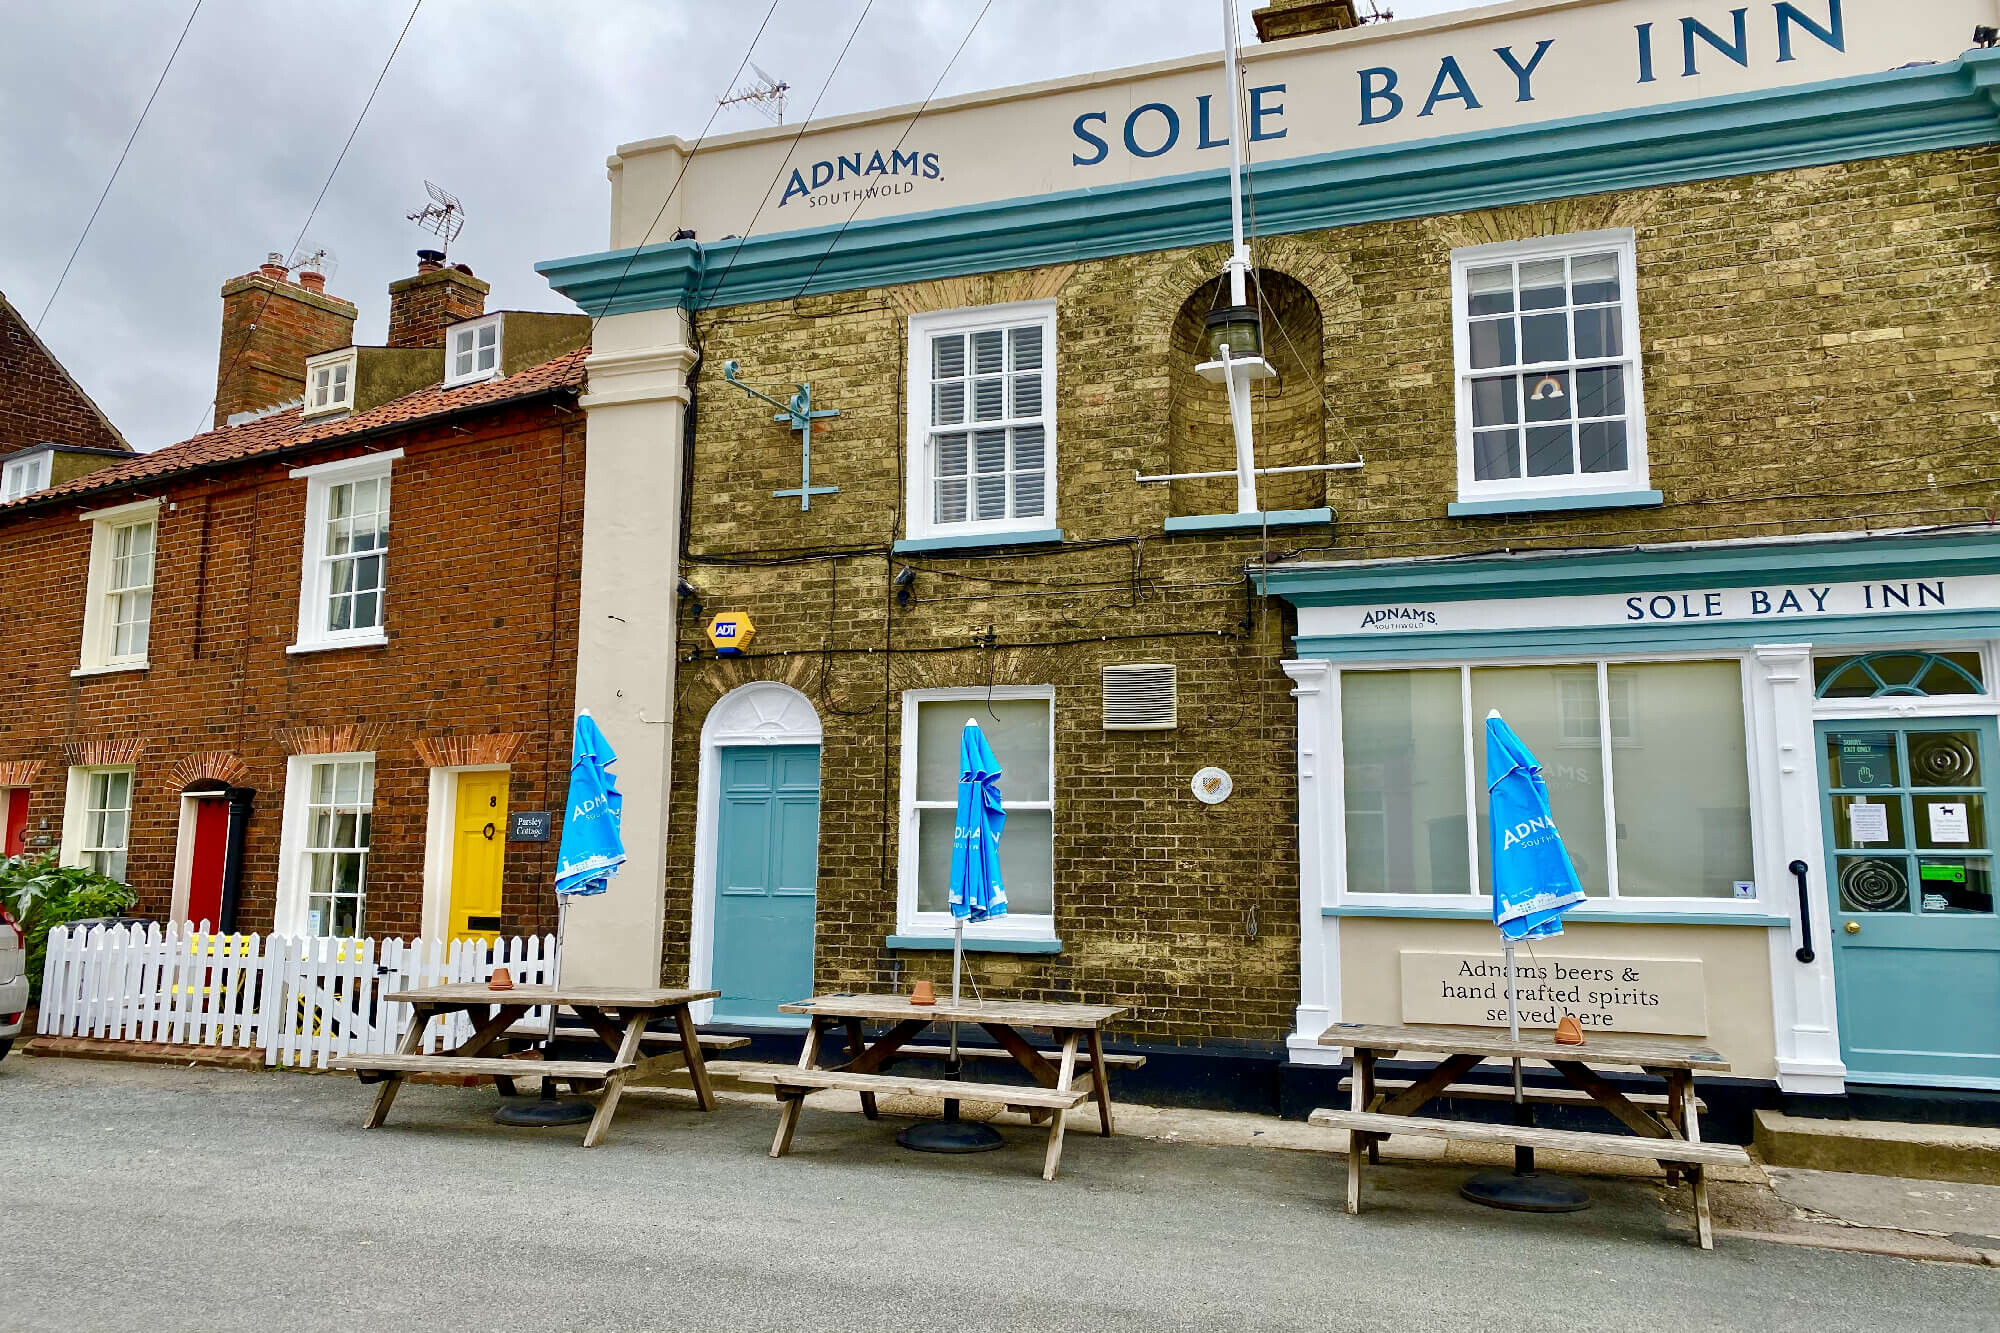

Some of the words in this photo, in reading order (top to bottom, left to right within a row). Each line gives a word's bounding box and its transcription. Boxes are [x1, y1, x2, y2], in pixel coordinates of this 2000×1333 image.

[1072, 83, 1288, 167] SOLE
[1357, 39, 1556, 127] BAY
[1634, 0, 1847, 84] INN
[809, 181, 914, 208] SOUTHWOLD
[1626, 592, 1723, 620] SOLE
[1751, 586, 1831, 615] BAY
[1863, 581, 1946, 609] INN
[715, 624, 736, 636] ADT
[1374, 622, 1424, 630] SOUTHWOLD
[490, 796, 497, 807] 8
[516, 827, 543, 838] Cottage
[518, 817, 543, 828] Parsley
[1503, 814, 1557, 851] ADNA
[1554, 962, 1614, 982] beers
[1622, 966, 1640, 982] &
[1441, 981, 1496, 1000] hand
[1588, 988, 1660, 1008] spirits
[1486, 1006, 1557, 1024] seved
[1563, 1006, 1614, 1026] here
